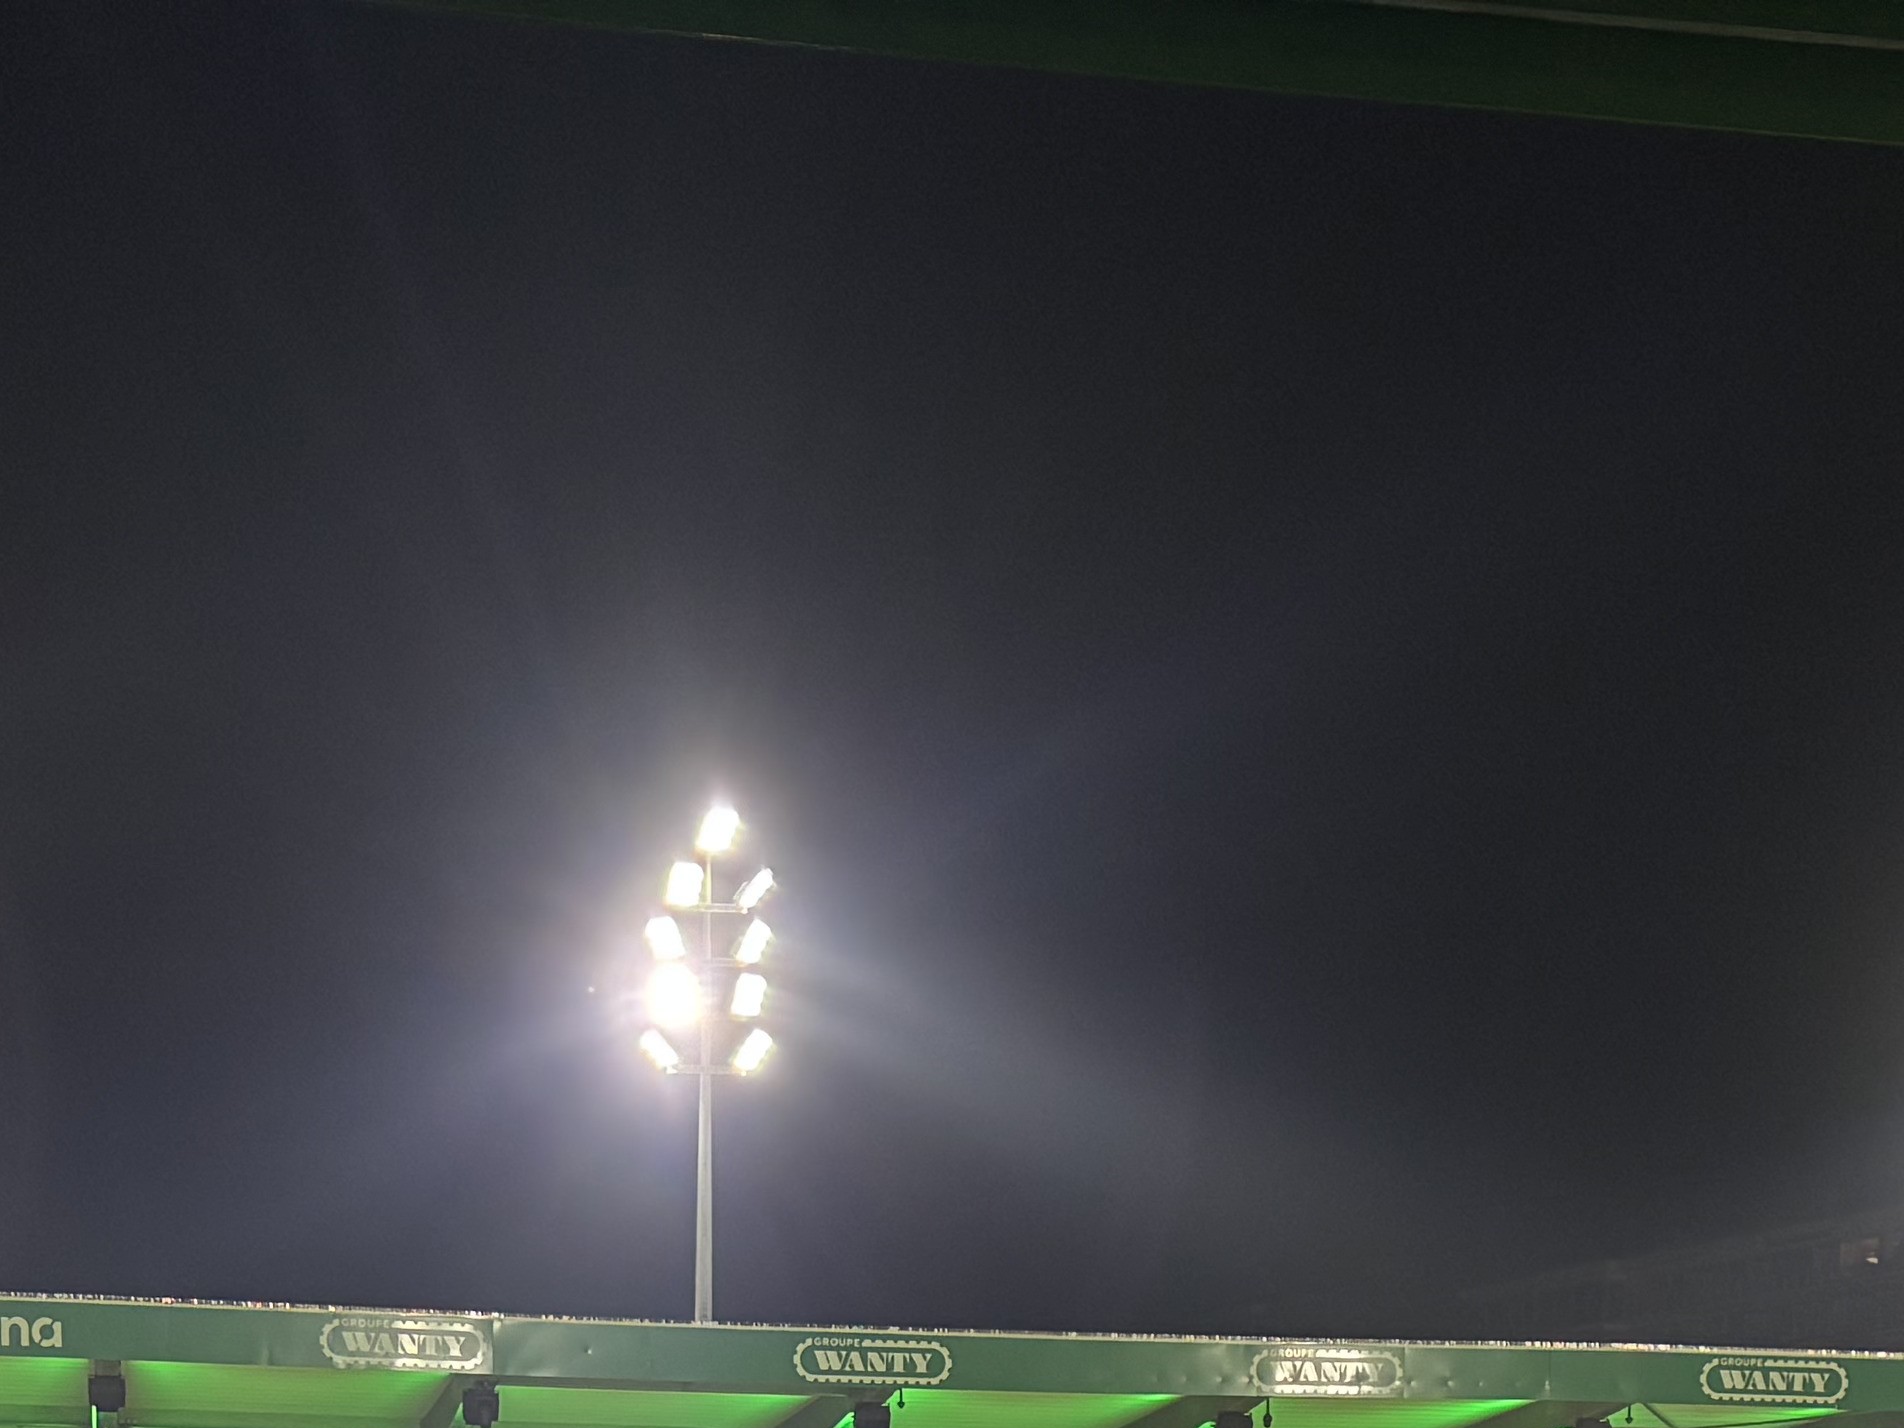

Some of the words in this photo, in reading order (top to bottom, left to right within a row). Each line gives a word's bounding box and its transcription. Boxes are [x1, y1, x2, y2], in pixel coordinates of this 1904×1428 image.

[341, 1331, 466, 1356] WANTY
[814, 1350, 932, 1373] WANTY
[1270, 1361, 1383, 1382] WANTY
[1720, 1369, 1830, 1392] WANTY
